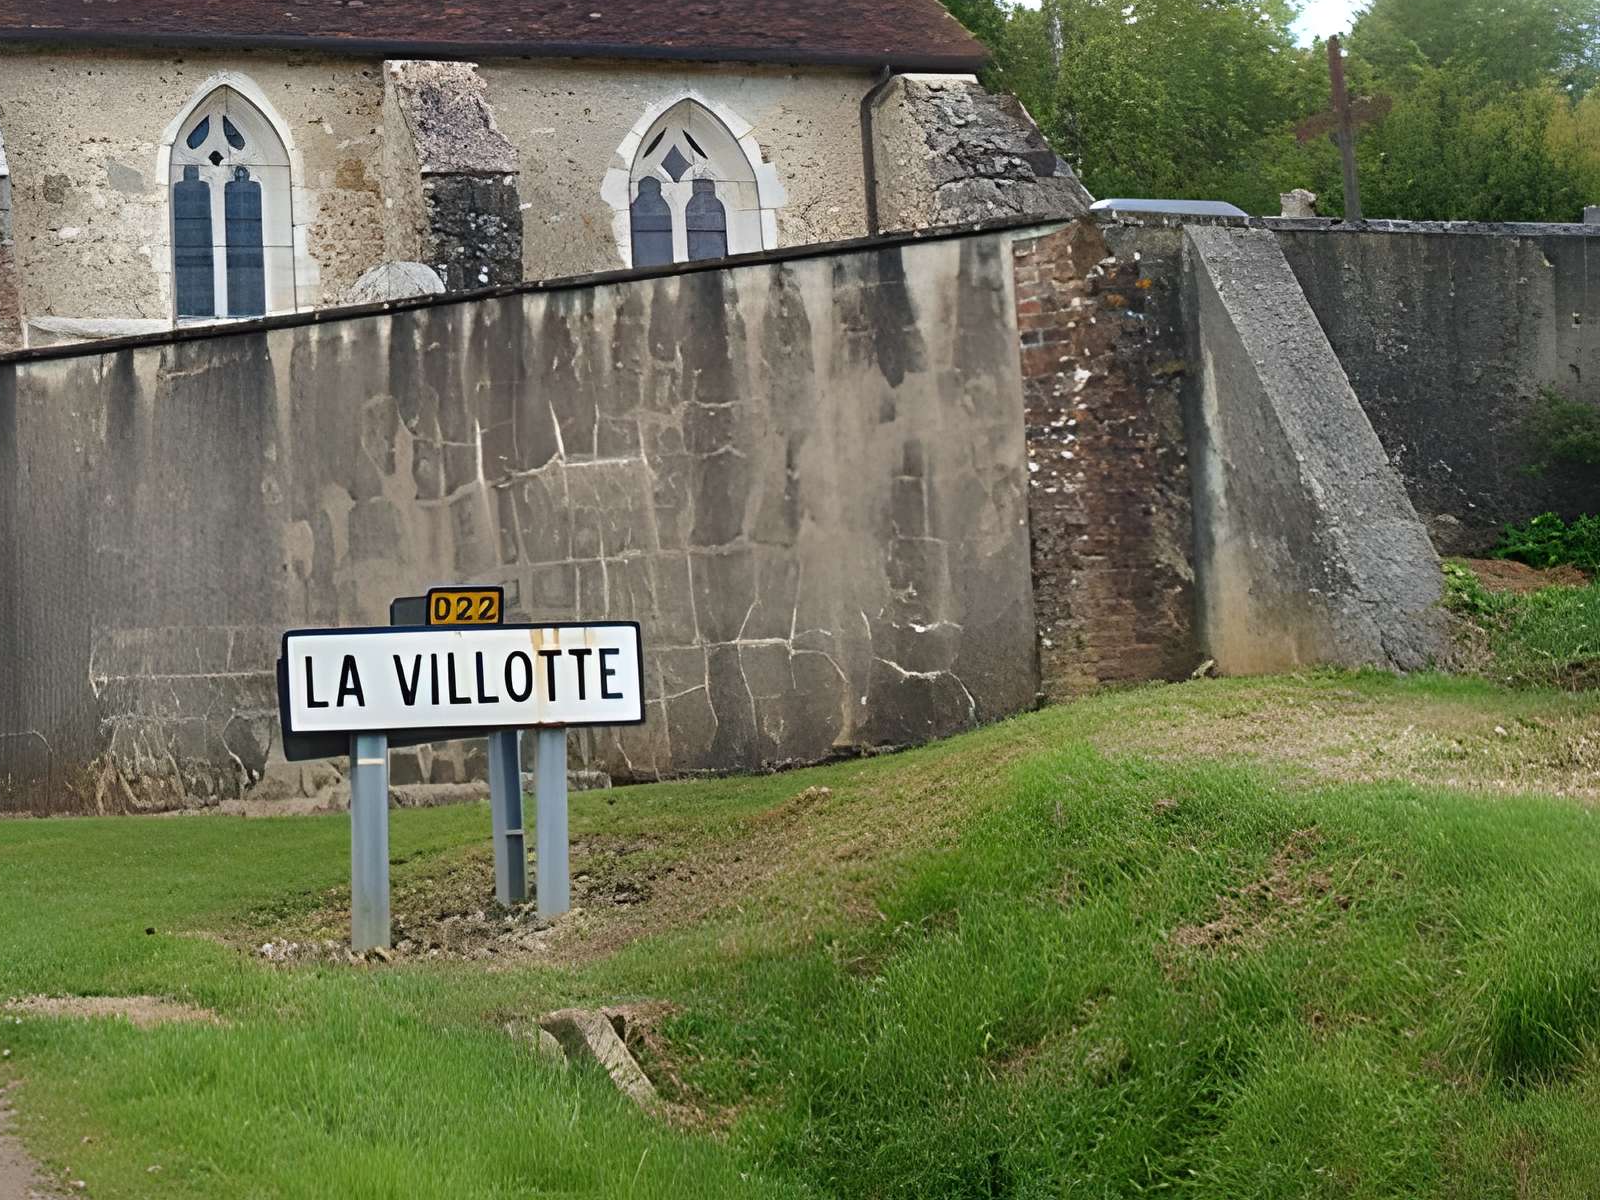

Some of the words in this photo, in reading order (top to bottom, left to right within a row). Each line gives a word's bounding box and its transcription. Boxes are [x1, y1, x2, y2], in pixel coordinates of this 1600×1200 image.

[434, 596, 495, 621] D22
[305, 654, 366, 709] LA
[392, 647, 624, 706] VILLOTTE
